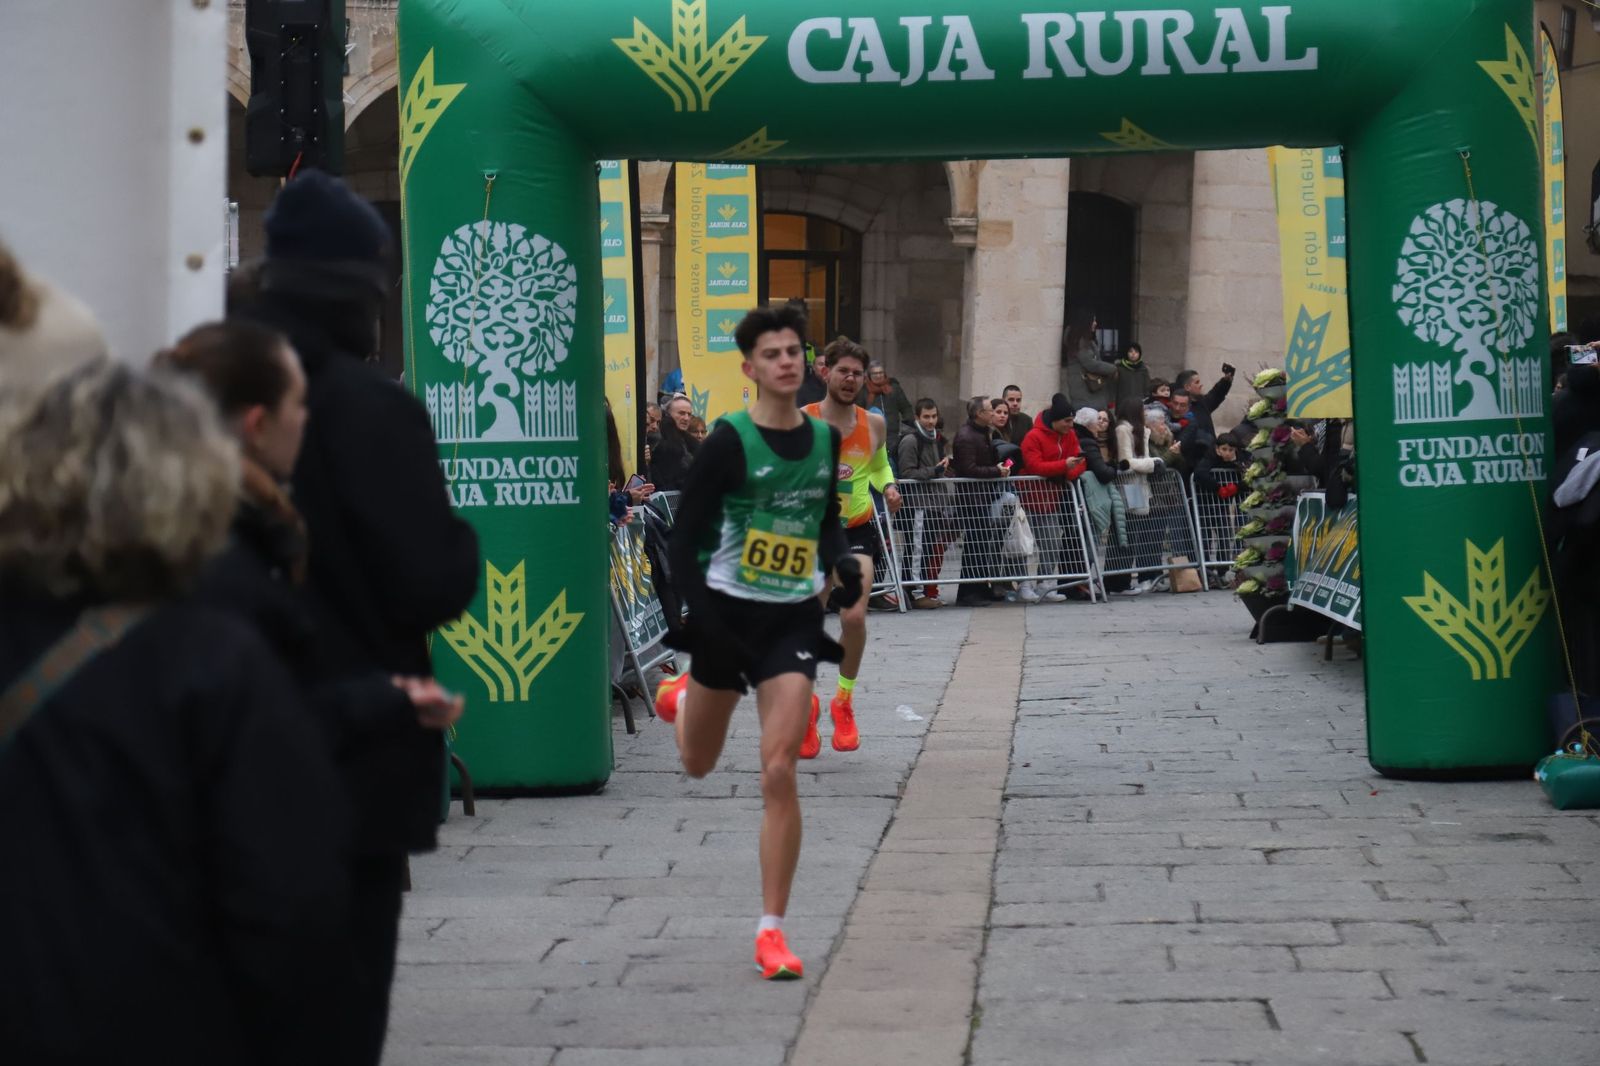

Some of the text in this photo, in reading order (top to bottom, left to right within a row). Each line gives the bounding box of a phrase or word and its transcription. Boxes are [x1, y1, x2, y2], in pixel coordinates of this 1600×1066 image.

[787, 5, 1318, 87] CAJA RURAL
[1398, 432, 1545, 461] FUNDACION
[439, 456, 579, 481] UNDACION
[1399, 458, 1547, 488] CAJA RURAL
[445, 481, 580, 508] AJA RURAL
[748, 538, 808, 576] 695
